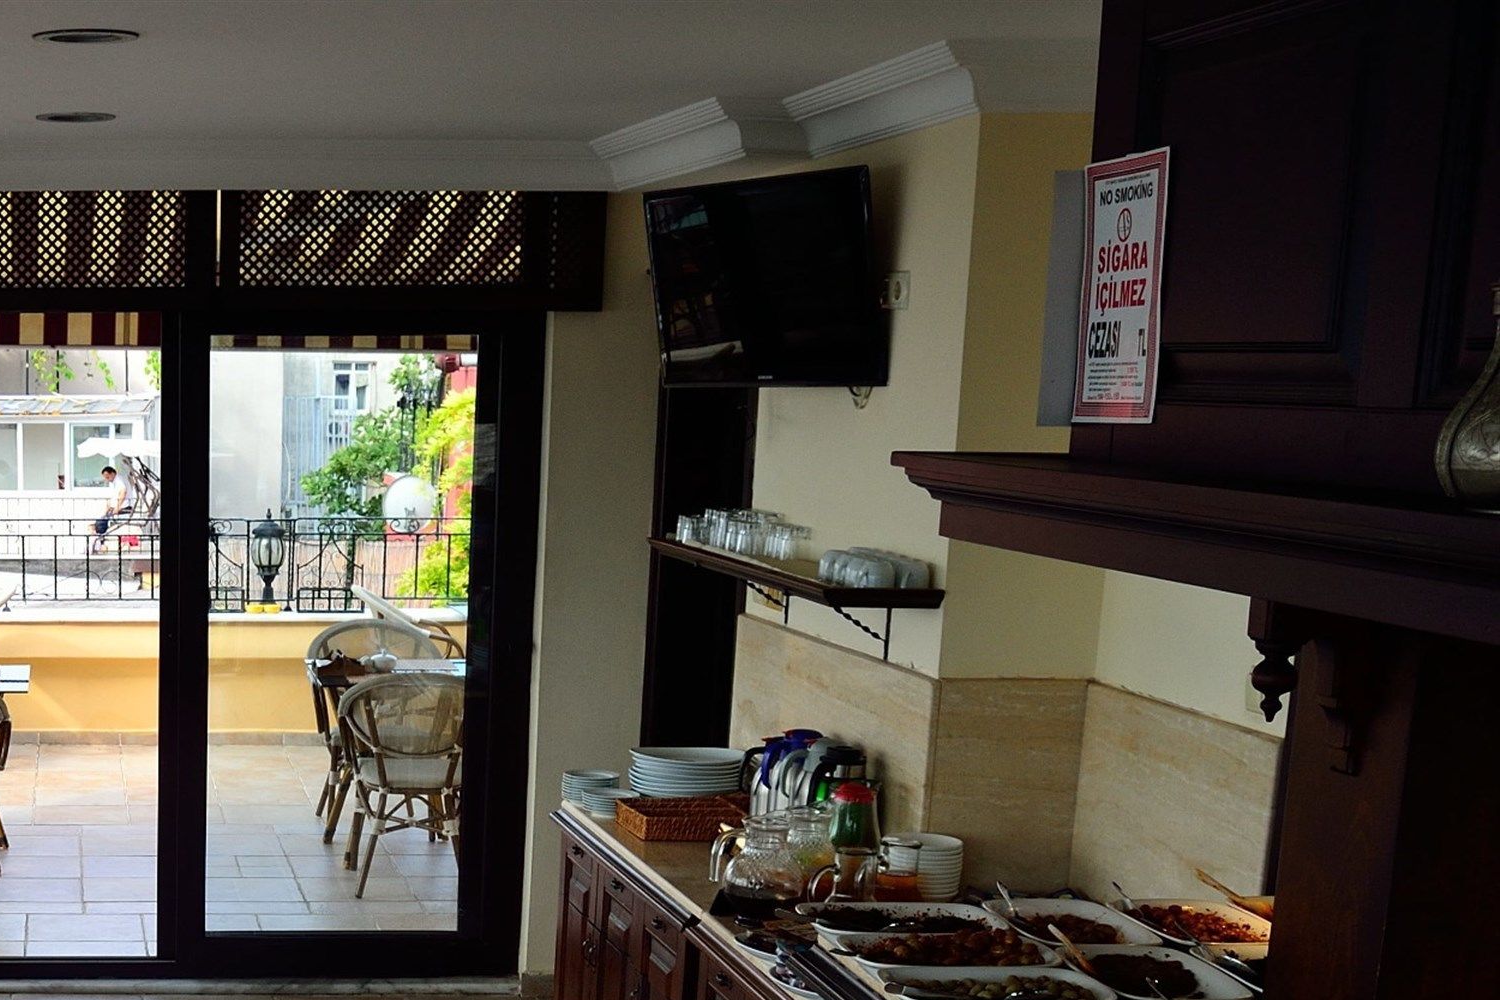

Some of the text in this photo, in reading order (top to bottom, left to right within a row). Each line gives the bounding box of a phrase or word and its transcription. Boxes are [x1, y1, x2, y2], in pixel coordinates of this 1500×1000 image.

[1100, 189, 1113, 206] NO
[1097, 240, 1148, 274] SİGARA
[1095, 275, 1146, 316] İÇİLMEZ
[1088, 321, 1121, 358] CEZASI
